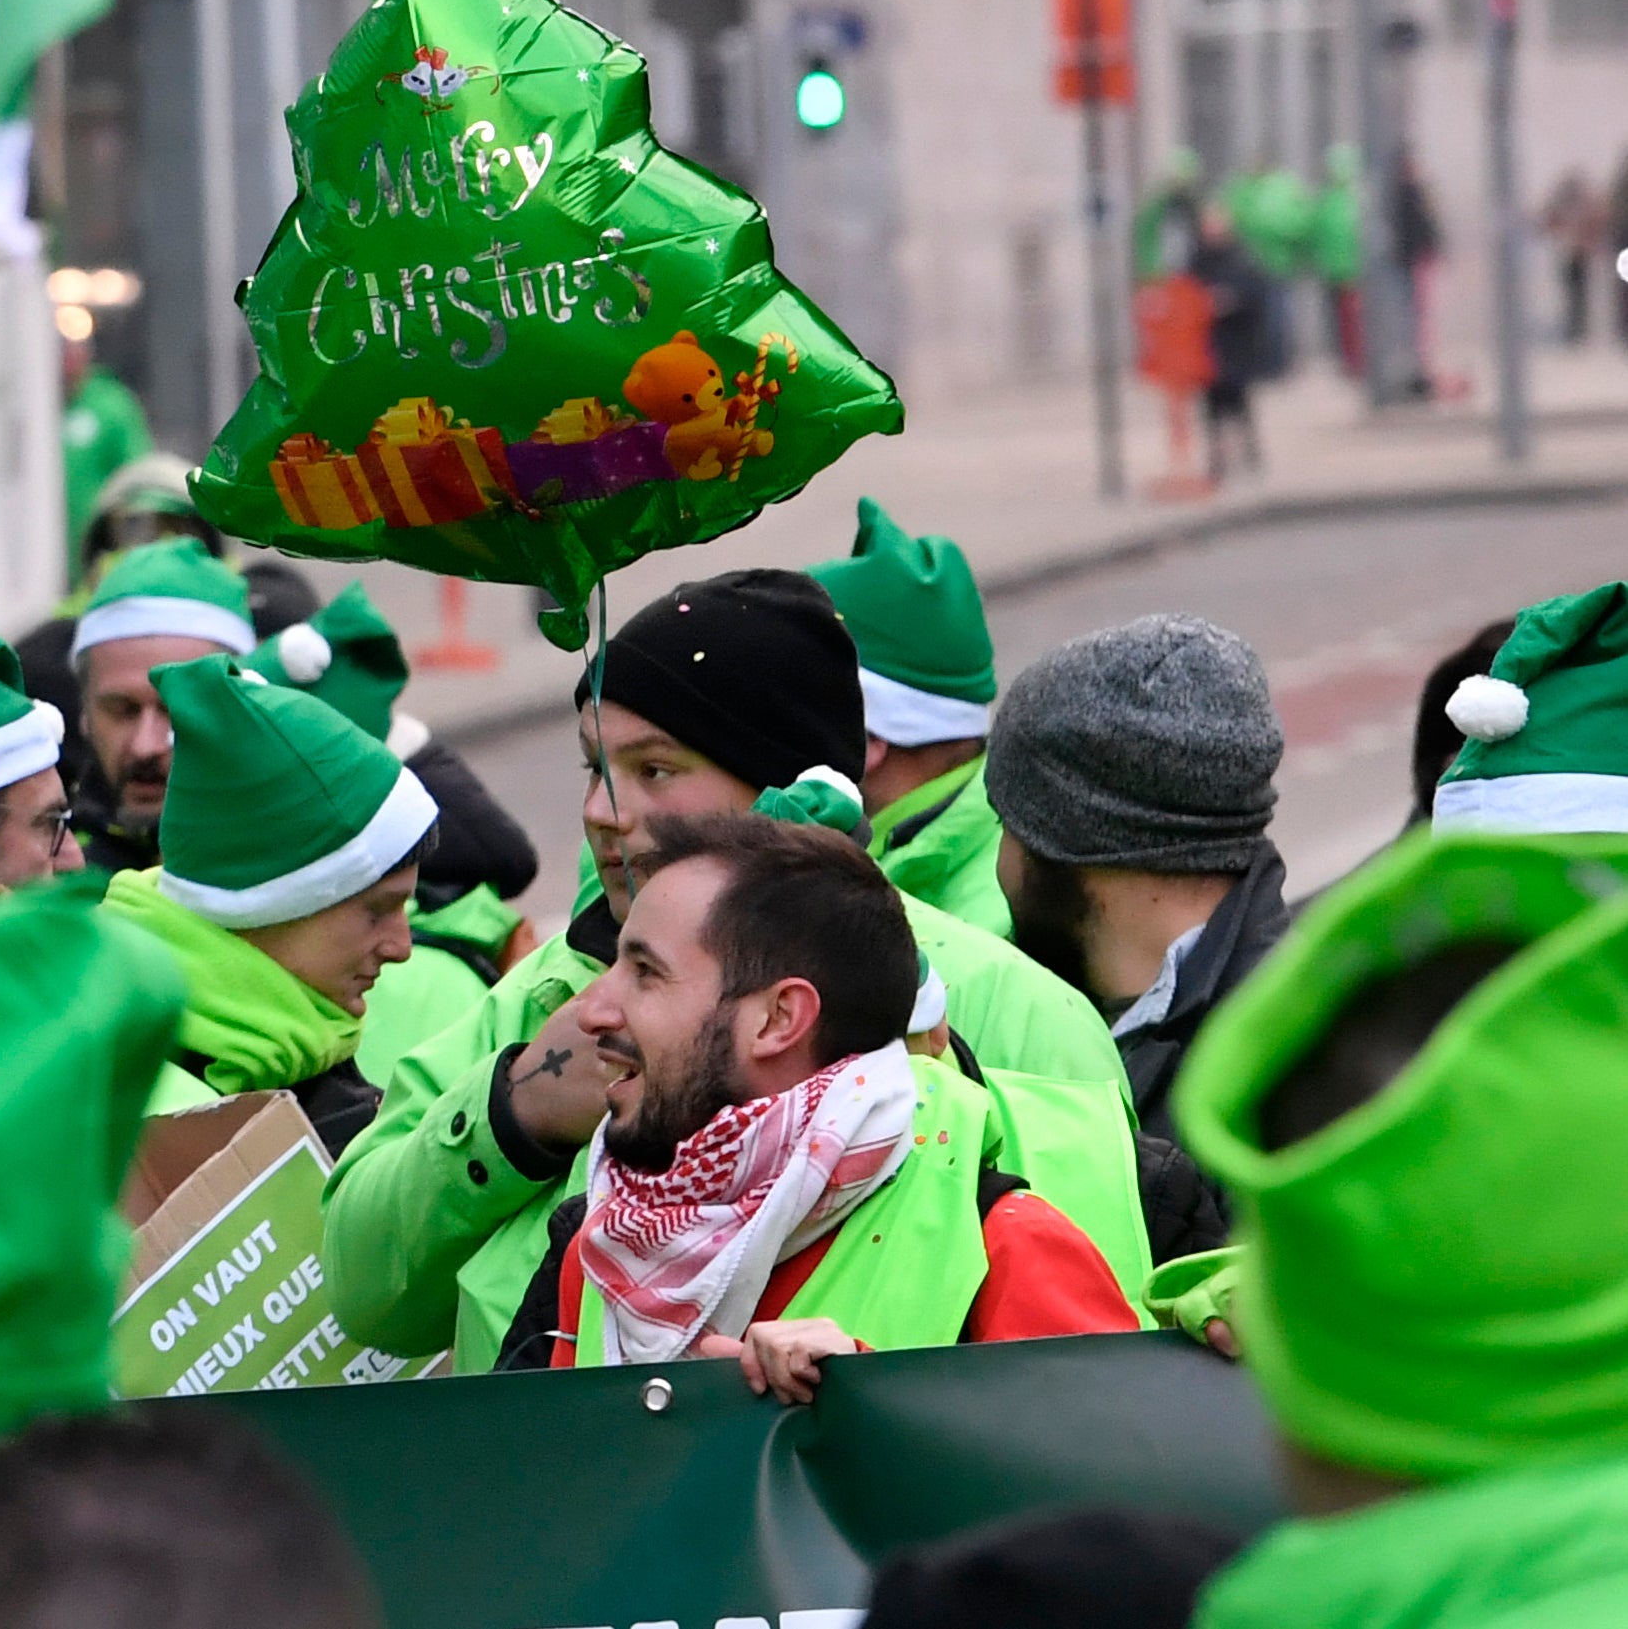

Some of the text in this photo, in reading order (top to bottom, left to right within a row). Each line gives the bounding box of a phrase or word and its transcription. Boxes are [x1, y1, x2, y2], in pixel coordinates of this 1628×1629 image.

[347, 120, 554, 229] Merry
[306, 227, 652, 369] Christmas
[149, 1219, 279, 1352] ON VAUT
[262, 1253, 324, 1325] QUE
